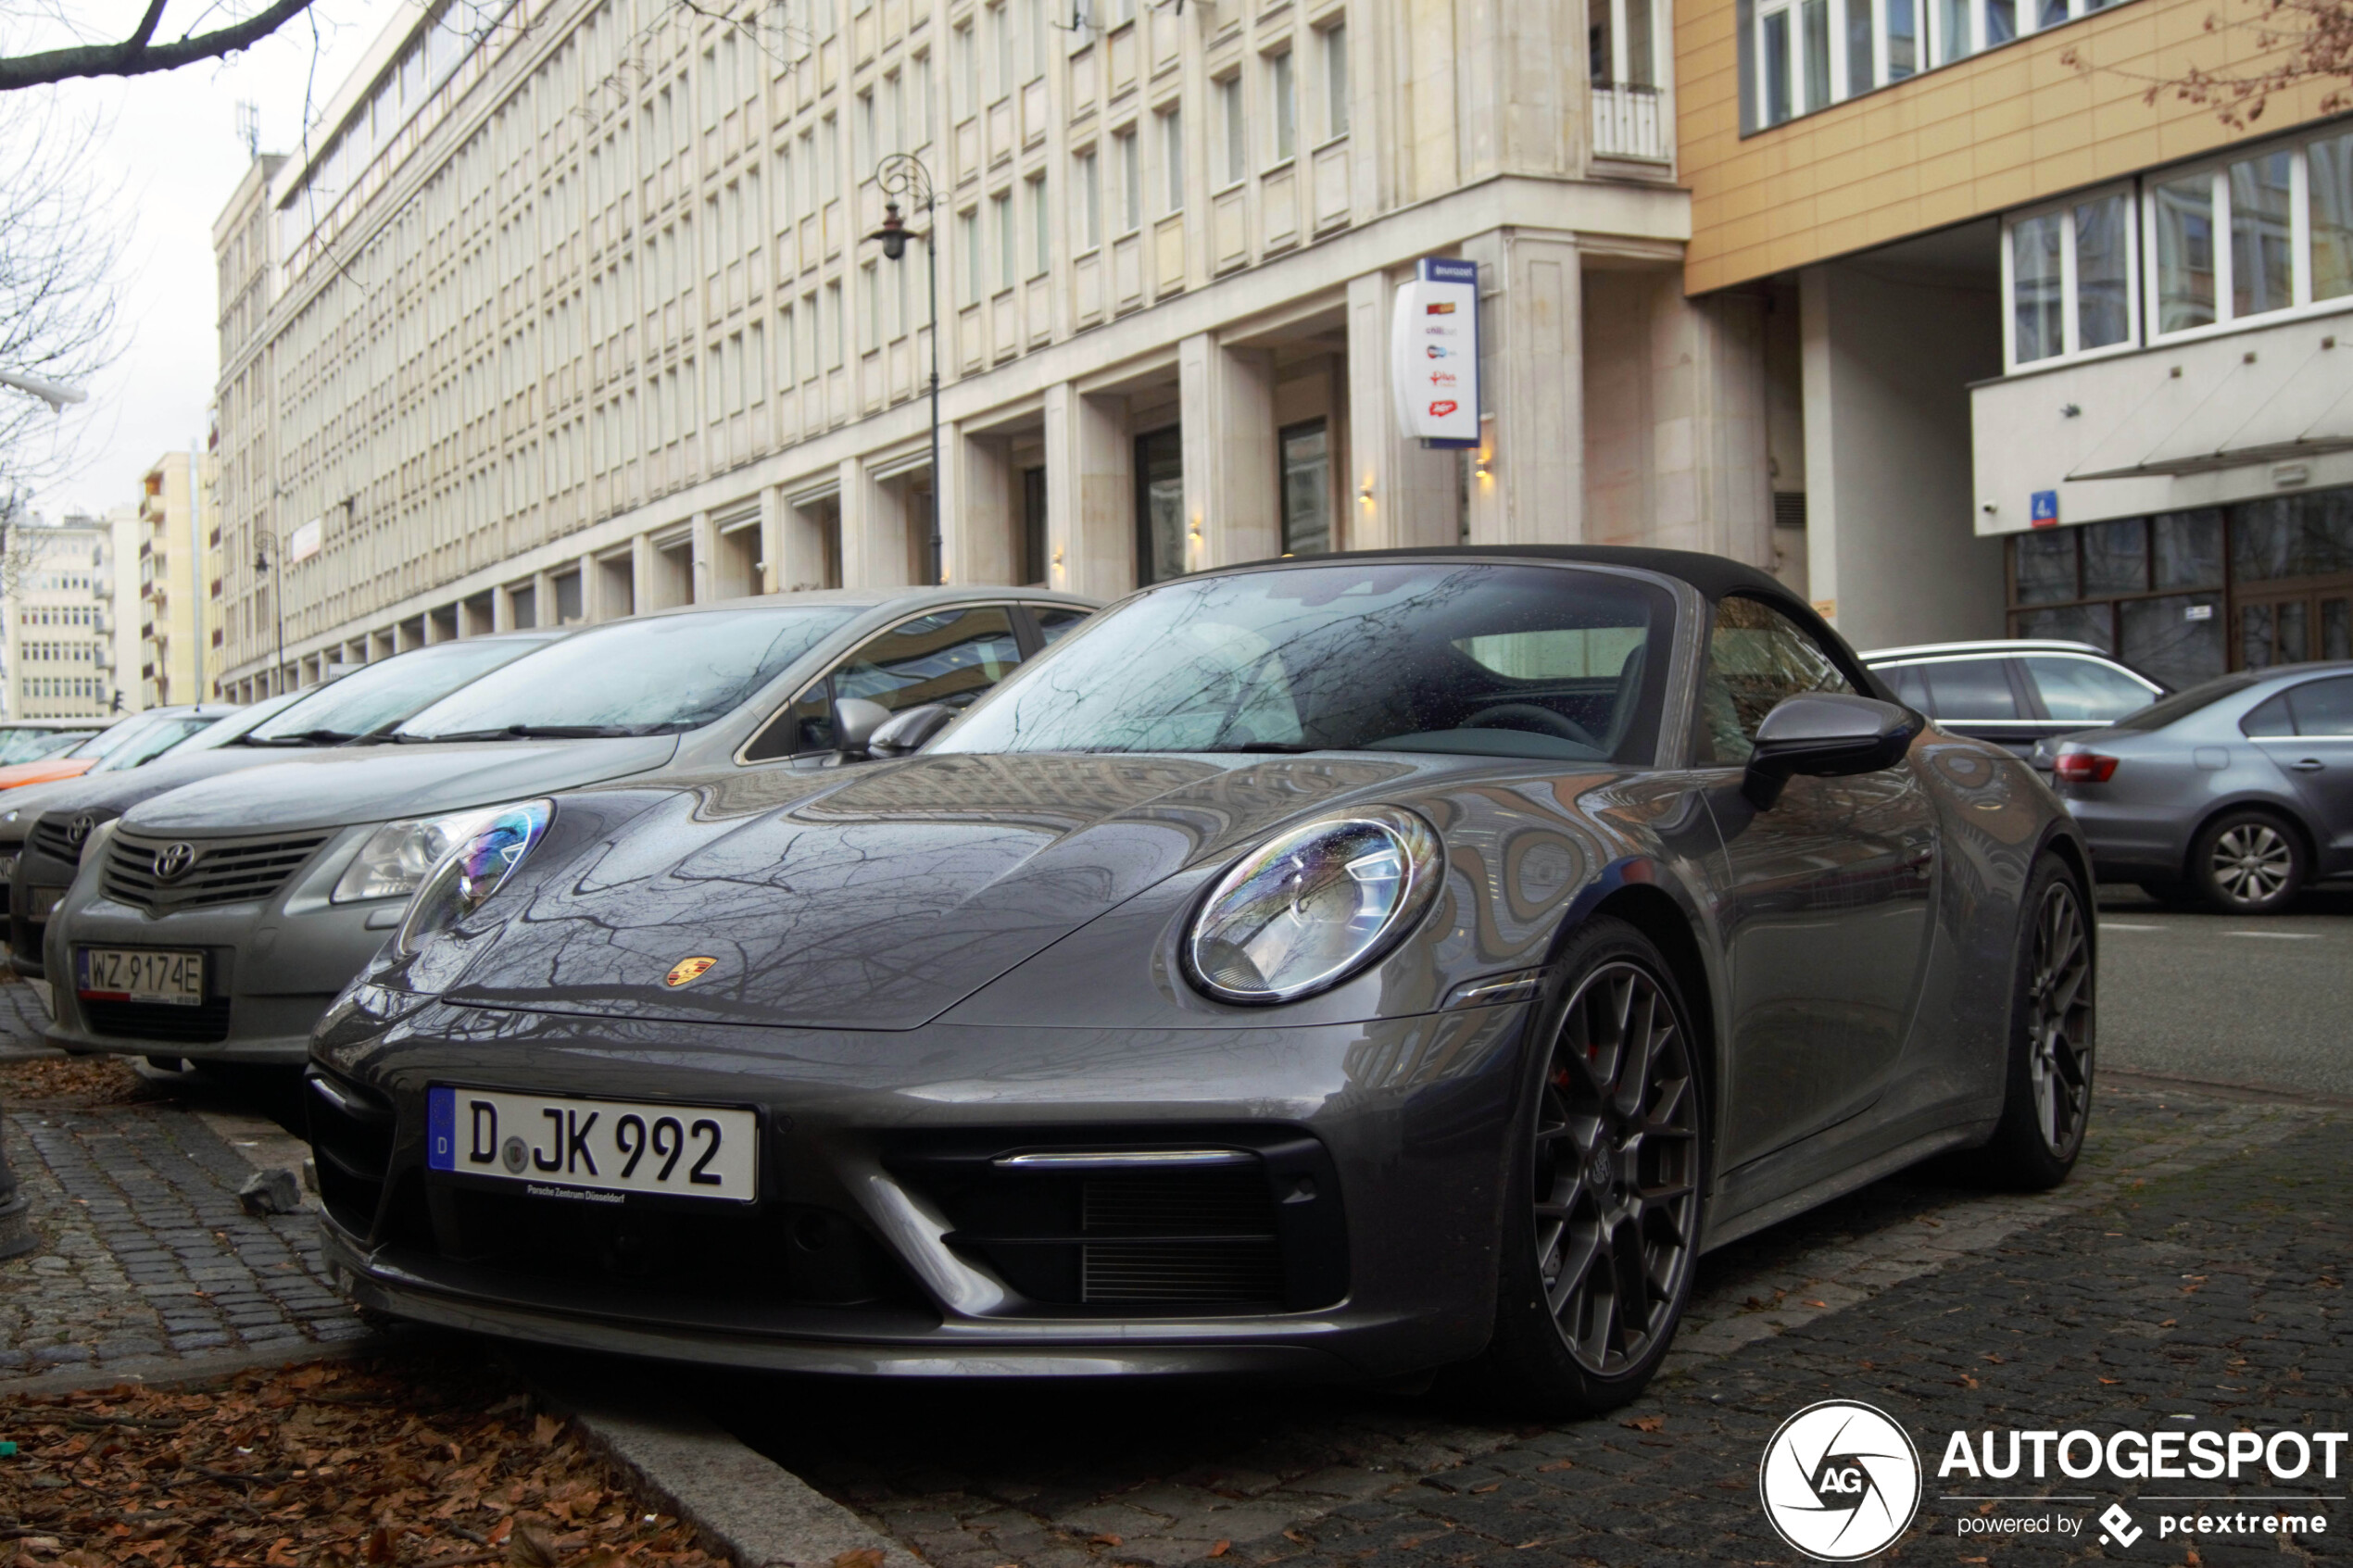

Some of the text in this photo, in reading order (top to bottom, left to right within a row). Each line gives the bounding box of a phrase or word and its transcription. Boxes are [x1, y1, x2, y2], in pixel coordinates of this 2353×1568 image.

[92, 952, 121, 988] WZ
[130, 954, 198, 993] 9174E
[437, 1136, 448, 1155] D
[470, 1099, 723, 1185] D JK 992
[527, 1185, 625, 1203] Porsche Zentrum Düsseldorf
